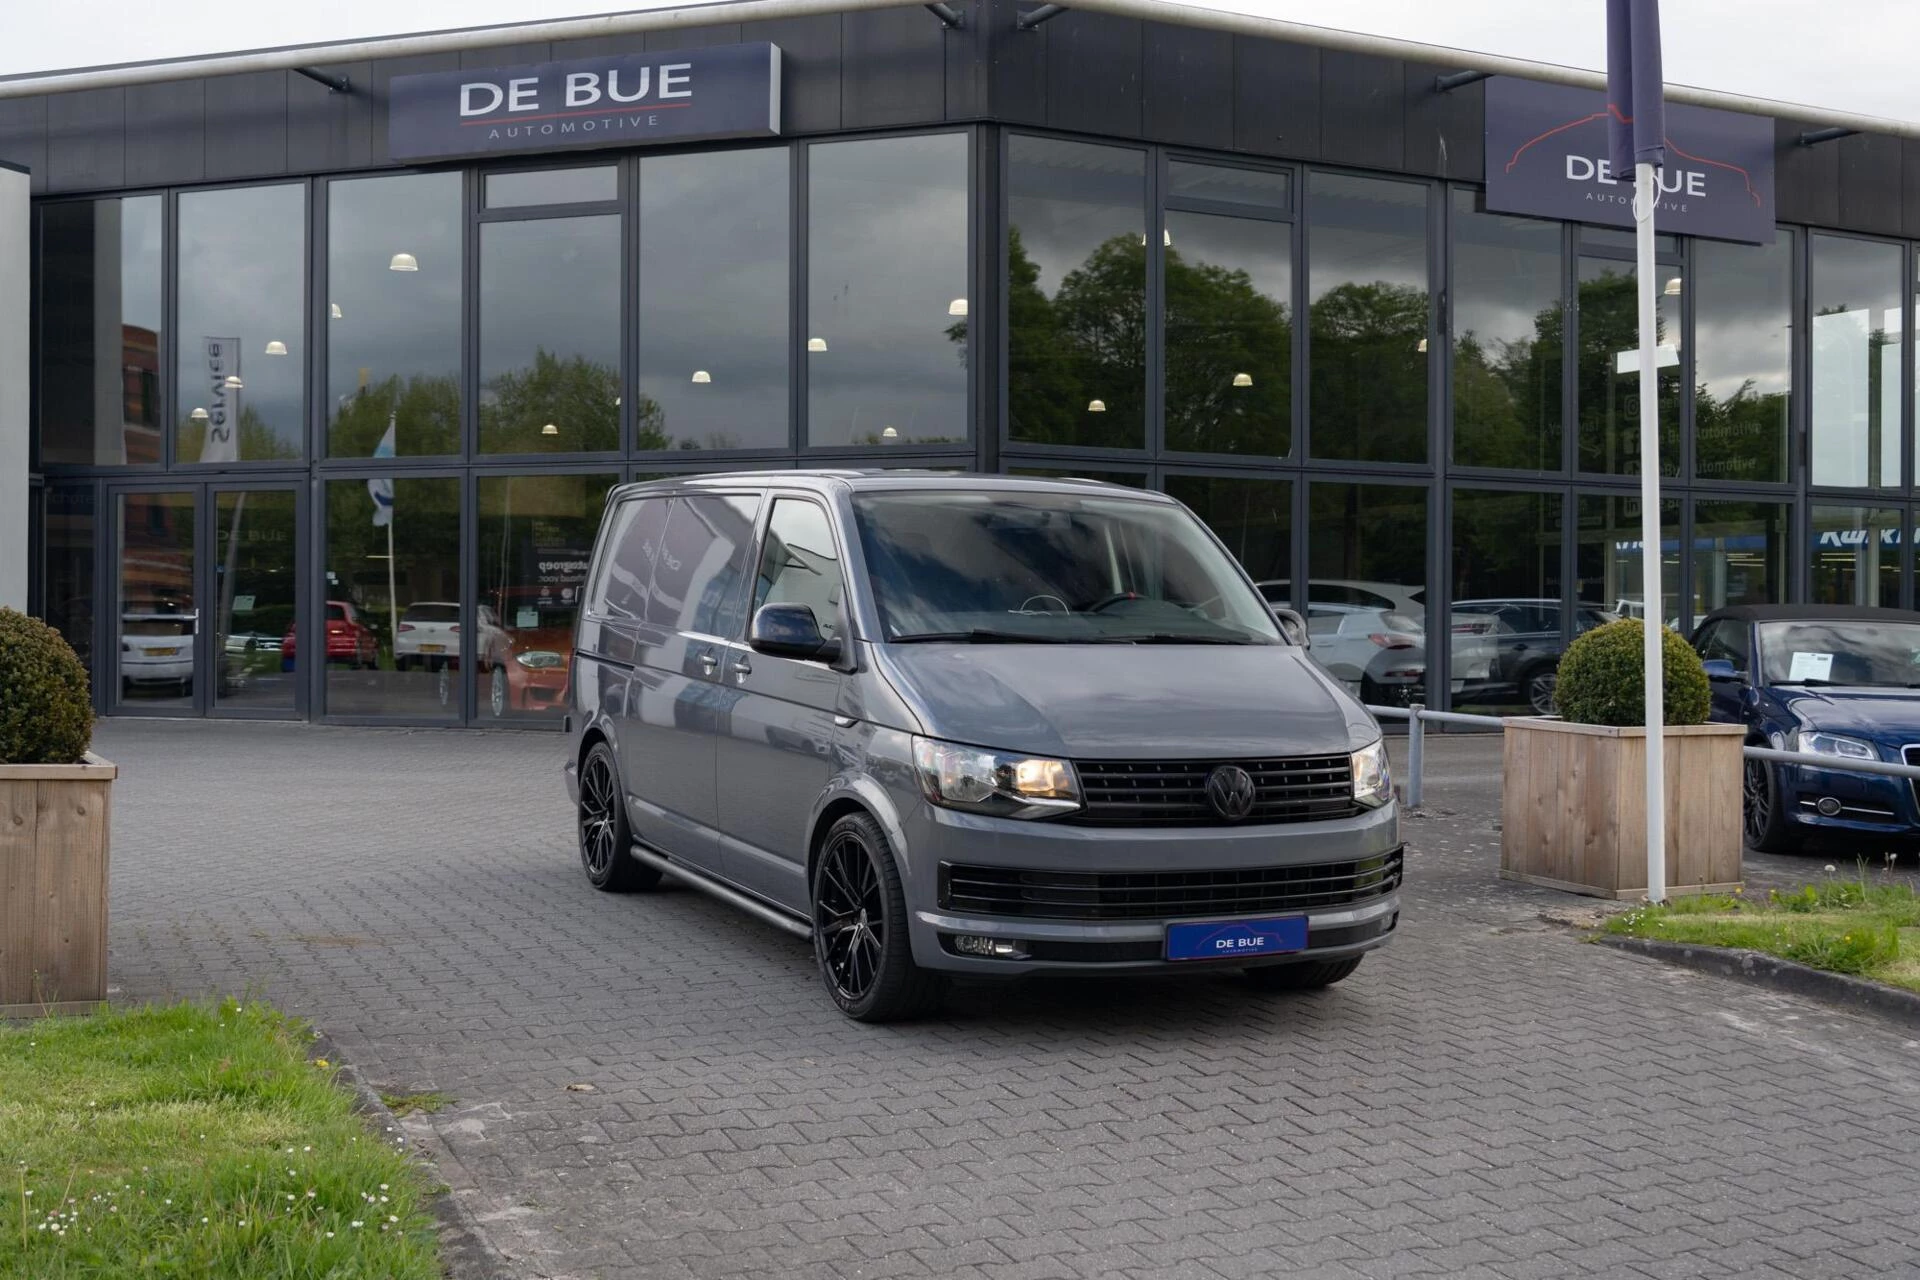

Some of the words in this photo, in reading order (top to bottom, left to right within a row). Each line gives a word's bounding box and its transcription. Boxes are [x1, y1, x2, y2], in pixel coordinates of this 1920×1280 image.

[460, 77, 539, 116] DE
[566, 63, 692, 107] BUE
[488, 114, 659, 139] AUTOMOTIVE
[1566, 154, 1617, 186] DE
[1633, 166, 1706, 197] UE
[1216, 939, 1235, 949] DE
[1238, 936, 1265, 947] BUE
